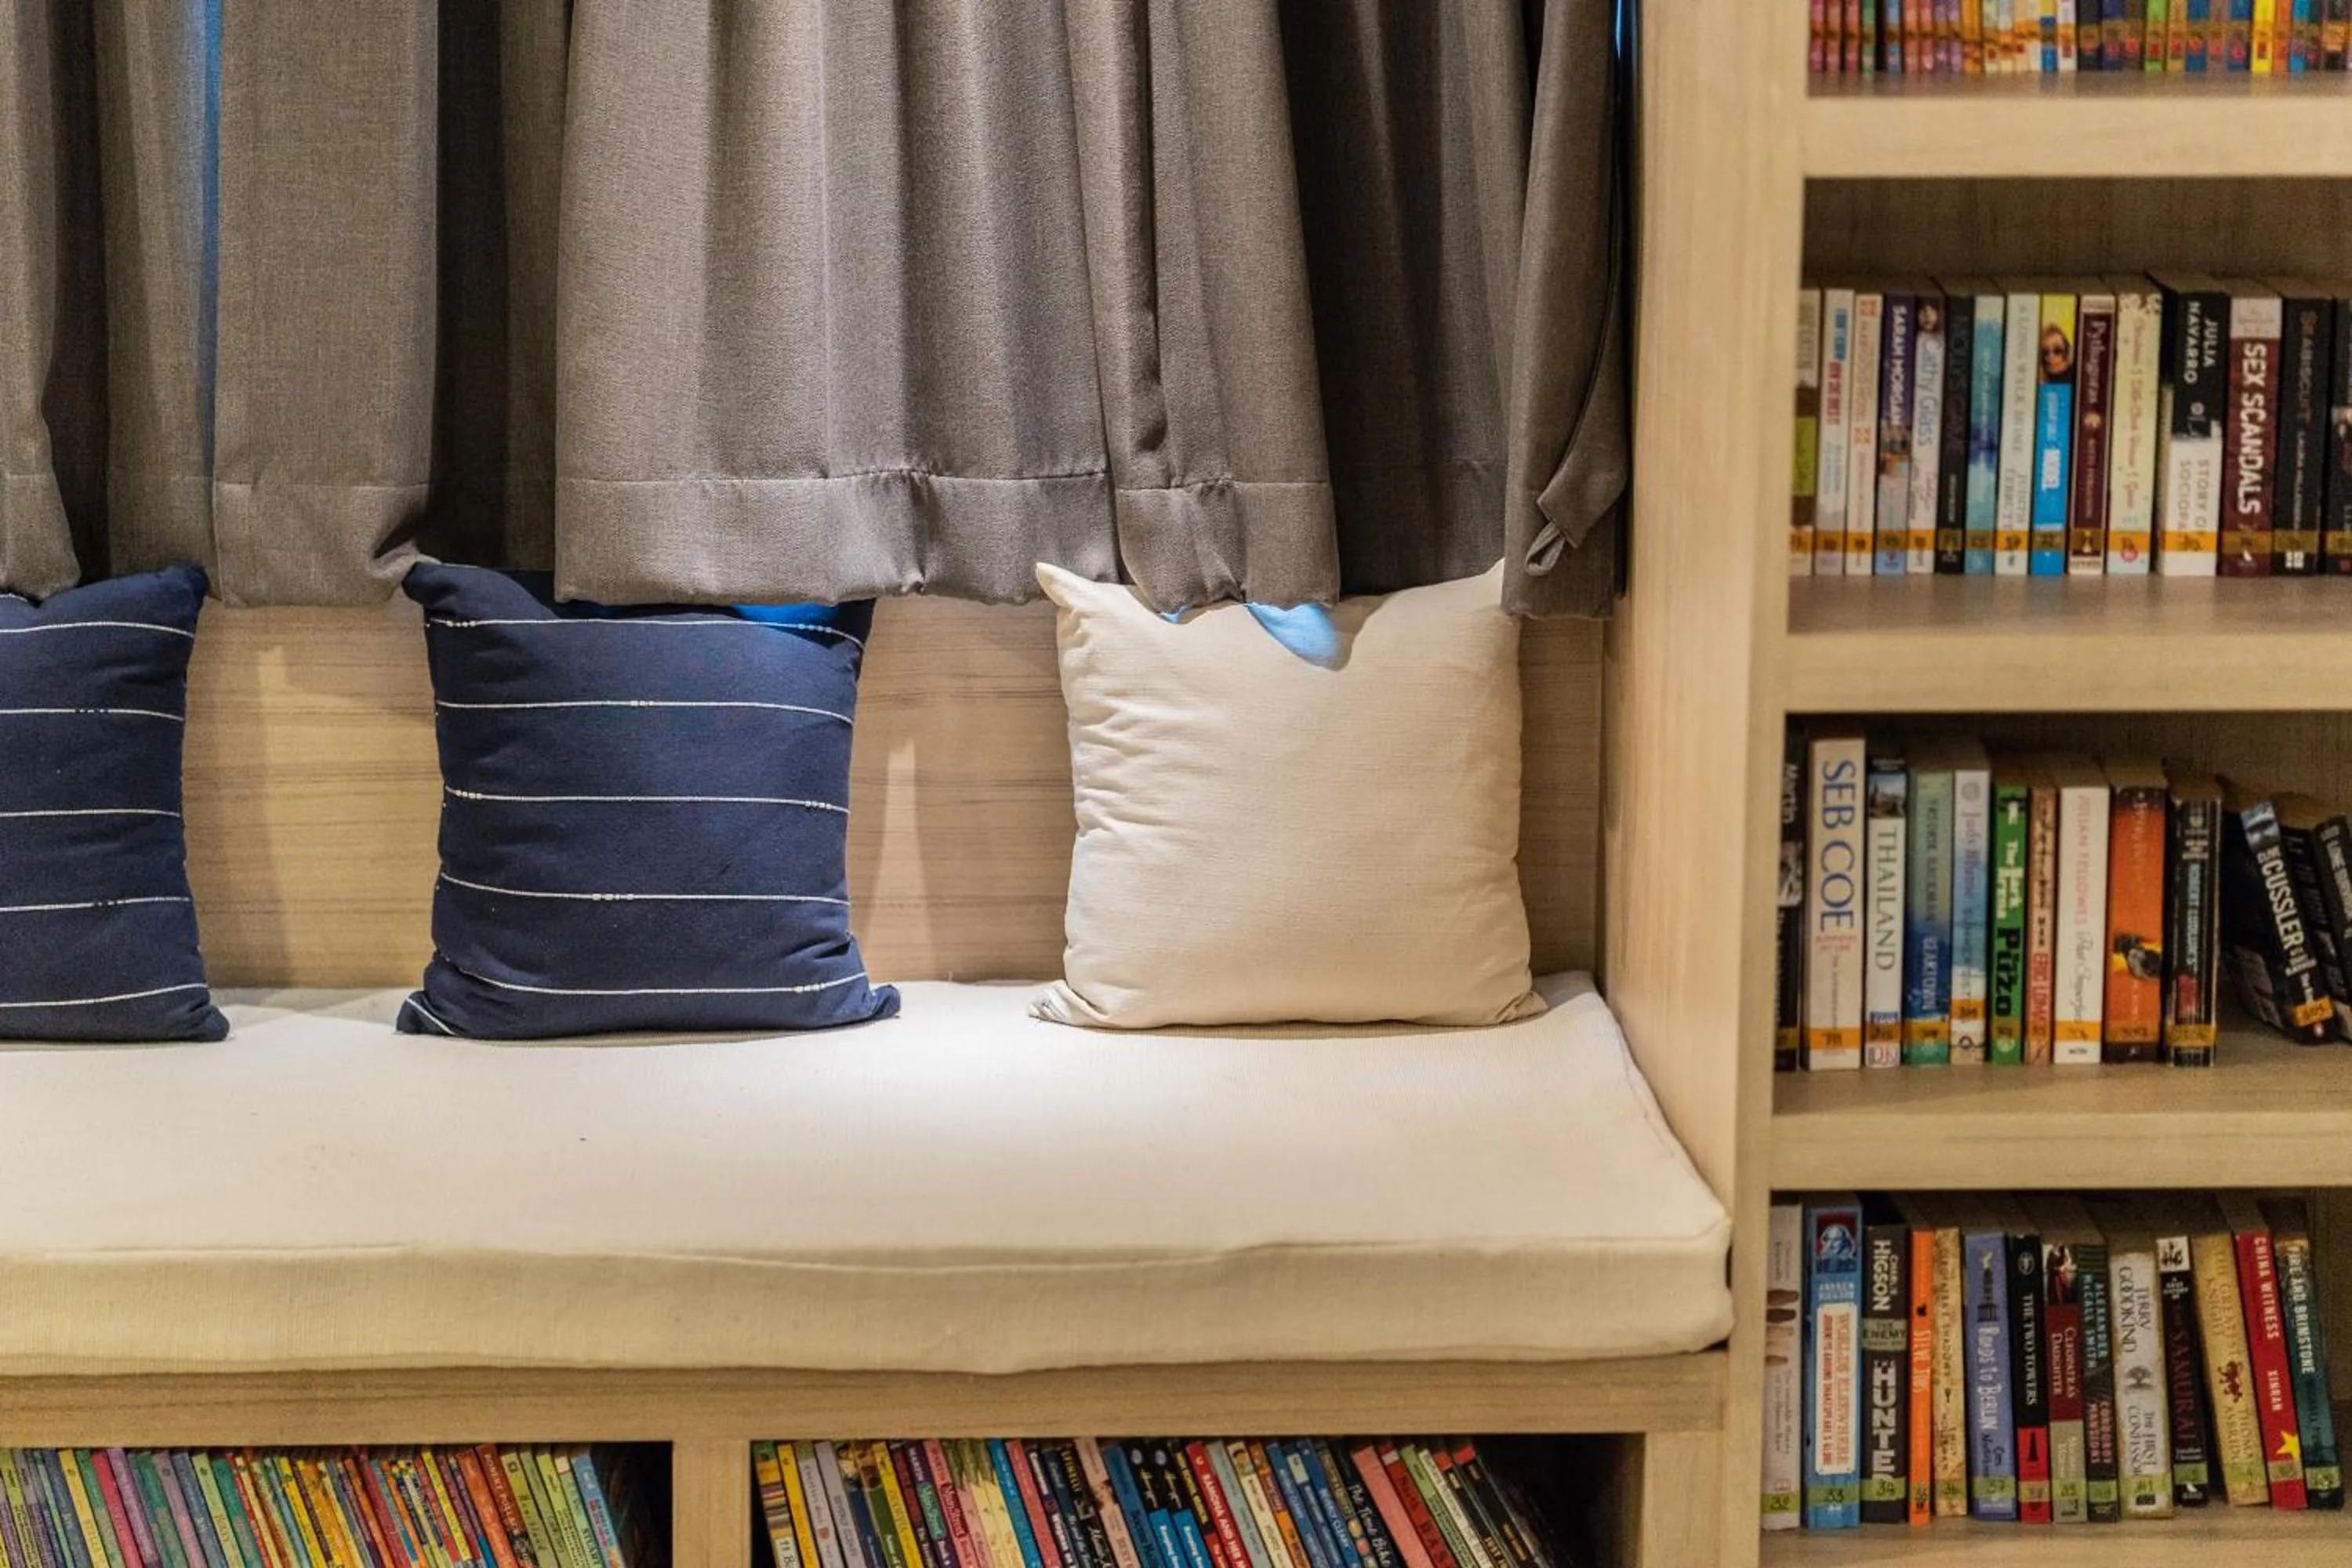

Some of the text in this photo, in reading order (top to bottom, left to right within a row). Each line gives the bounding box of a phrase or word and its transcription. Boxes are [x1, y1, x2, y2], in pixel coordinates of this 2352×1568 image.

[1889, 305, 1907, 425] SARAH MORGAN
[2085, 320, 2107, 404] Pythagoras
[2183, 301, 2201, 384] NAVARRO
[2203, 318, 2219, 367] JULIA
[1918, 396, 1939, 447] Glass
[2238, 343, 2267, 515] SEX SCANDALS
[2176, 459, 2192, 535] SOCIOPA
[2195, 459, 2210, 510] STORY
[1822, 760, 1857, 830] SEB
[1819, 840, 1857, 932] COE
[2005, 840, 2018, 865] The
[1875, 827, 1898, 971] THAILAND
[2261, 859, 2305, 951] CUSSLER
[1922, 936, 1938, 1011] BEARTOWN
[1995, 927, 2021, 1017] Puzo
[2031, 953, 2049, 983] ERIC
[1872, 1240, 1891, 1311] HIGSON
[1889, 1254, 1900, 1295] CHARLIE
[2286, 1243, 2301, 1276] FIRE
[2290, 1278, 2305, 1304] AND
[2095, 1283, 2107, 1358] ALEXANDER
[2118, 1265, 2139, 1354] GOODKIND
[2134, 1286, 2151, 1331] TERRY
[2254, 1236, 2283, 1411] CHINA WITNESS XINRAN
[2294, 1304, 2316, 1374] BRIMSTONE
[1913, 1330, 1931, 1394] STEVE JOBS
[2022, 1293, 2038, 1406] THE TWO TOWERS
[2051, 1333, 2065, 1396] DAUGHTER
[2063, 1326, 2080, 1399] CLEOPATRA'S
[2085, 1327, 2097, 1369] SMITH
[1977, 1385, 2004, 1430] BERLIN
[2170, 1331, 2196, 1447] SAMURAI
[2088, 1403, 2100, 1464] MANSIONS
[2100, 1400, 2112, 1464] CORDUROY
[2141, 1430, 2158, 1468] FIRST
[2223, 1406, 2241, 1461] ASBRID
[2237, 1406, 2254, 1463] THOMA
[1202, 1472, 1240, 1559] RAMONA AND HER
